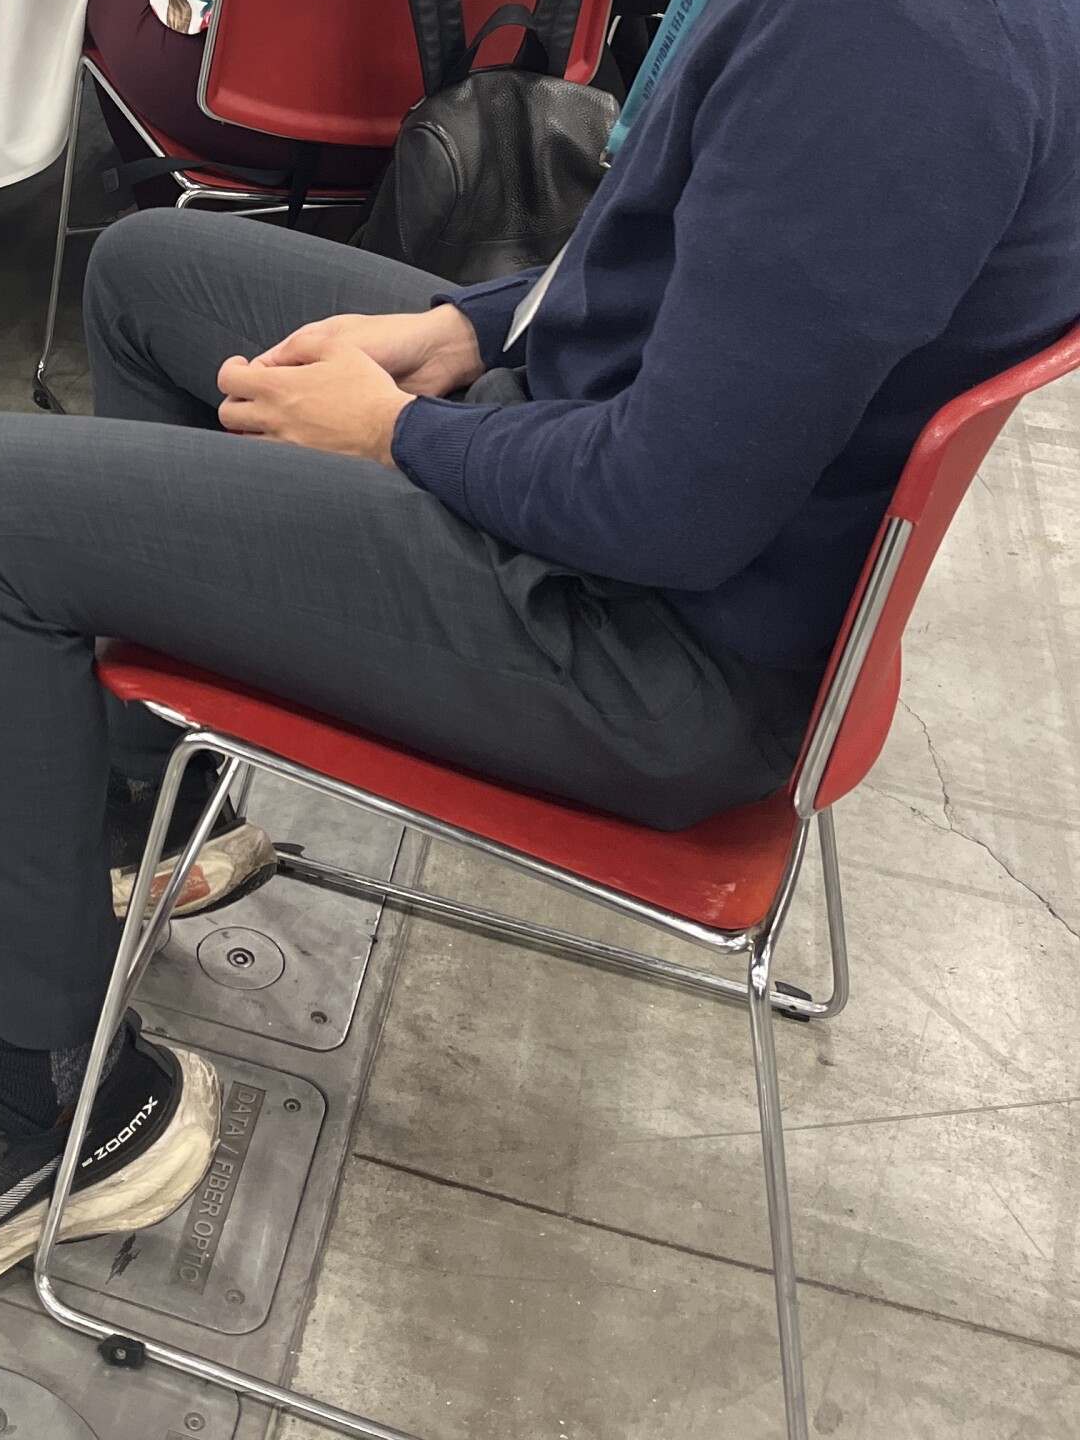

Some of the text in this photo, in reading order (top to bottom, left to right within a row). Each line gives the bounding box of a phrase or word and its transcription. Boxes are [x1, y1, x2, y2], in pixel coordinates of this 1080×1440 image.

[650, 31, 676, 77] NATIONAL
[671, 10, 686, 34] FFA
[224, 1088, 258, 1137] DATA
[198, 1159, 234, 1217] FIBER
[178, 1221, 214, 1283] OPTIC
